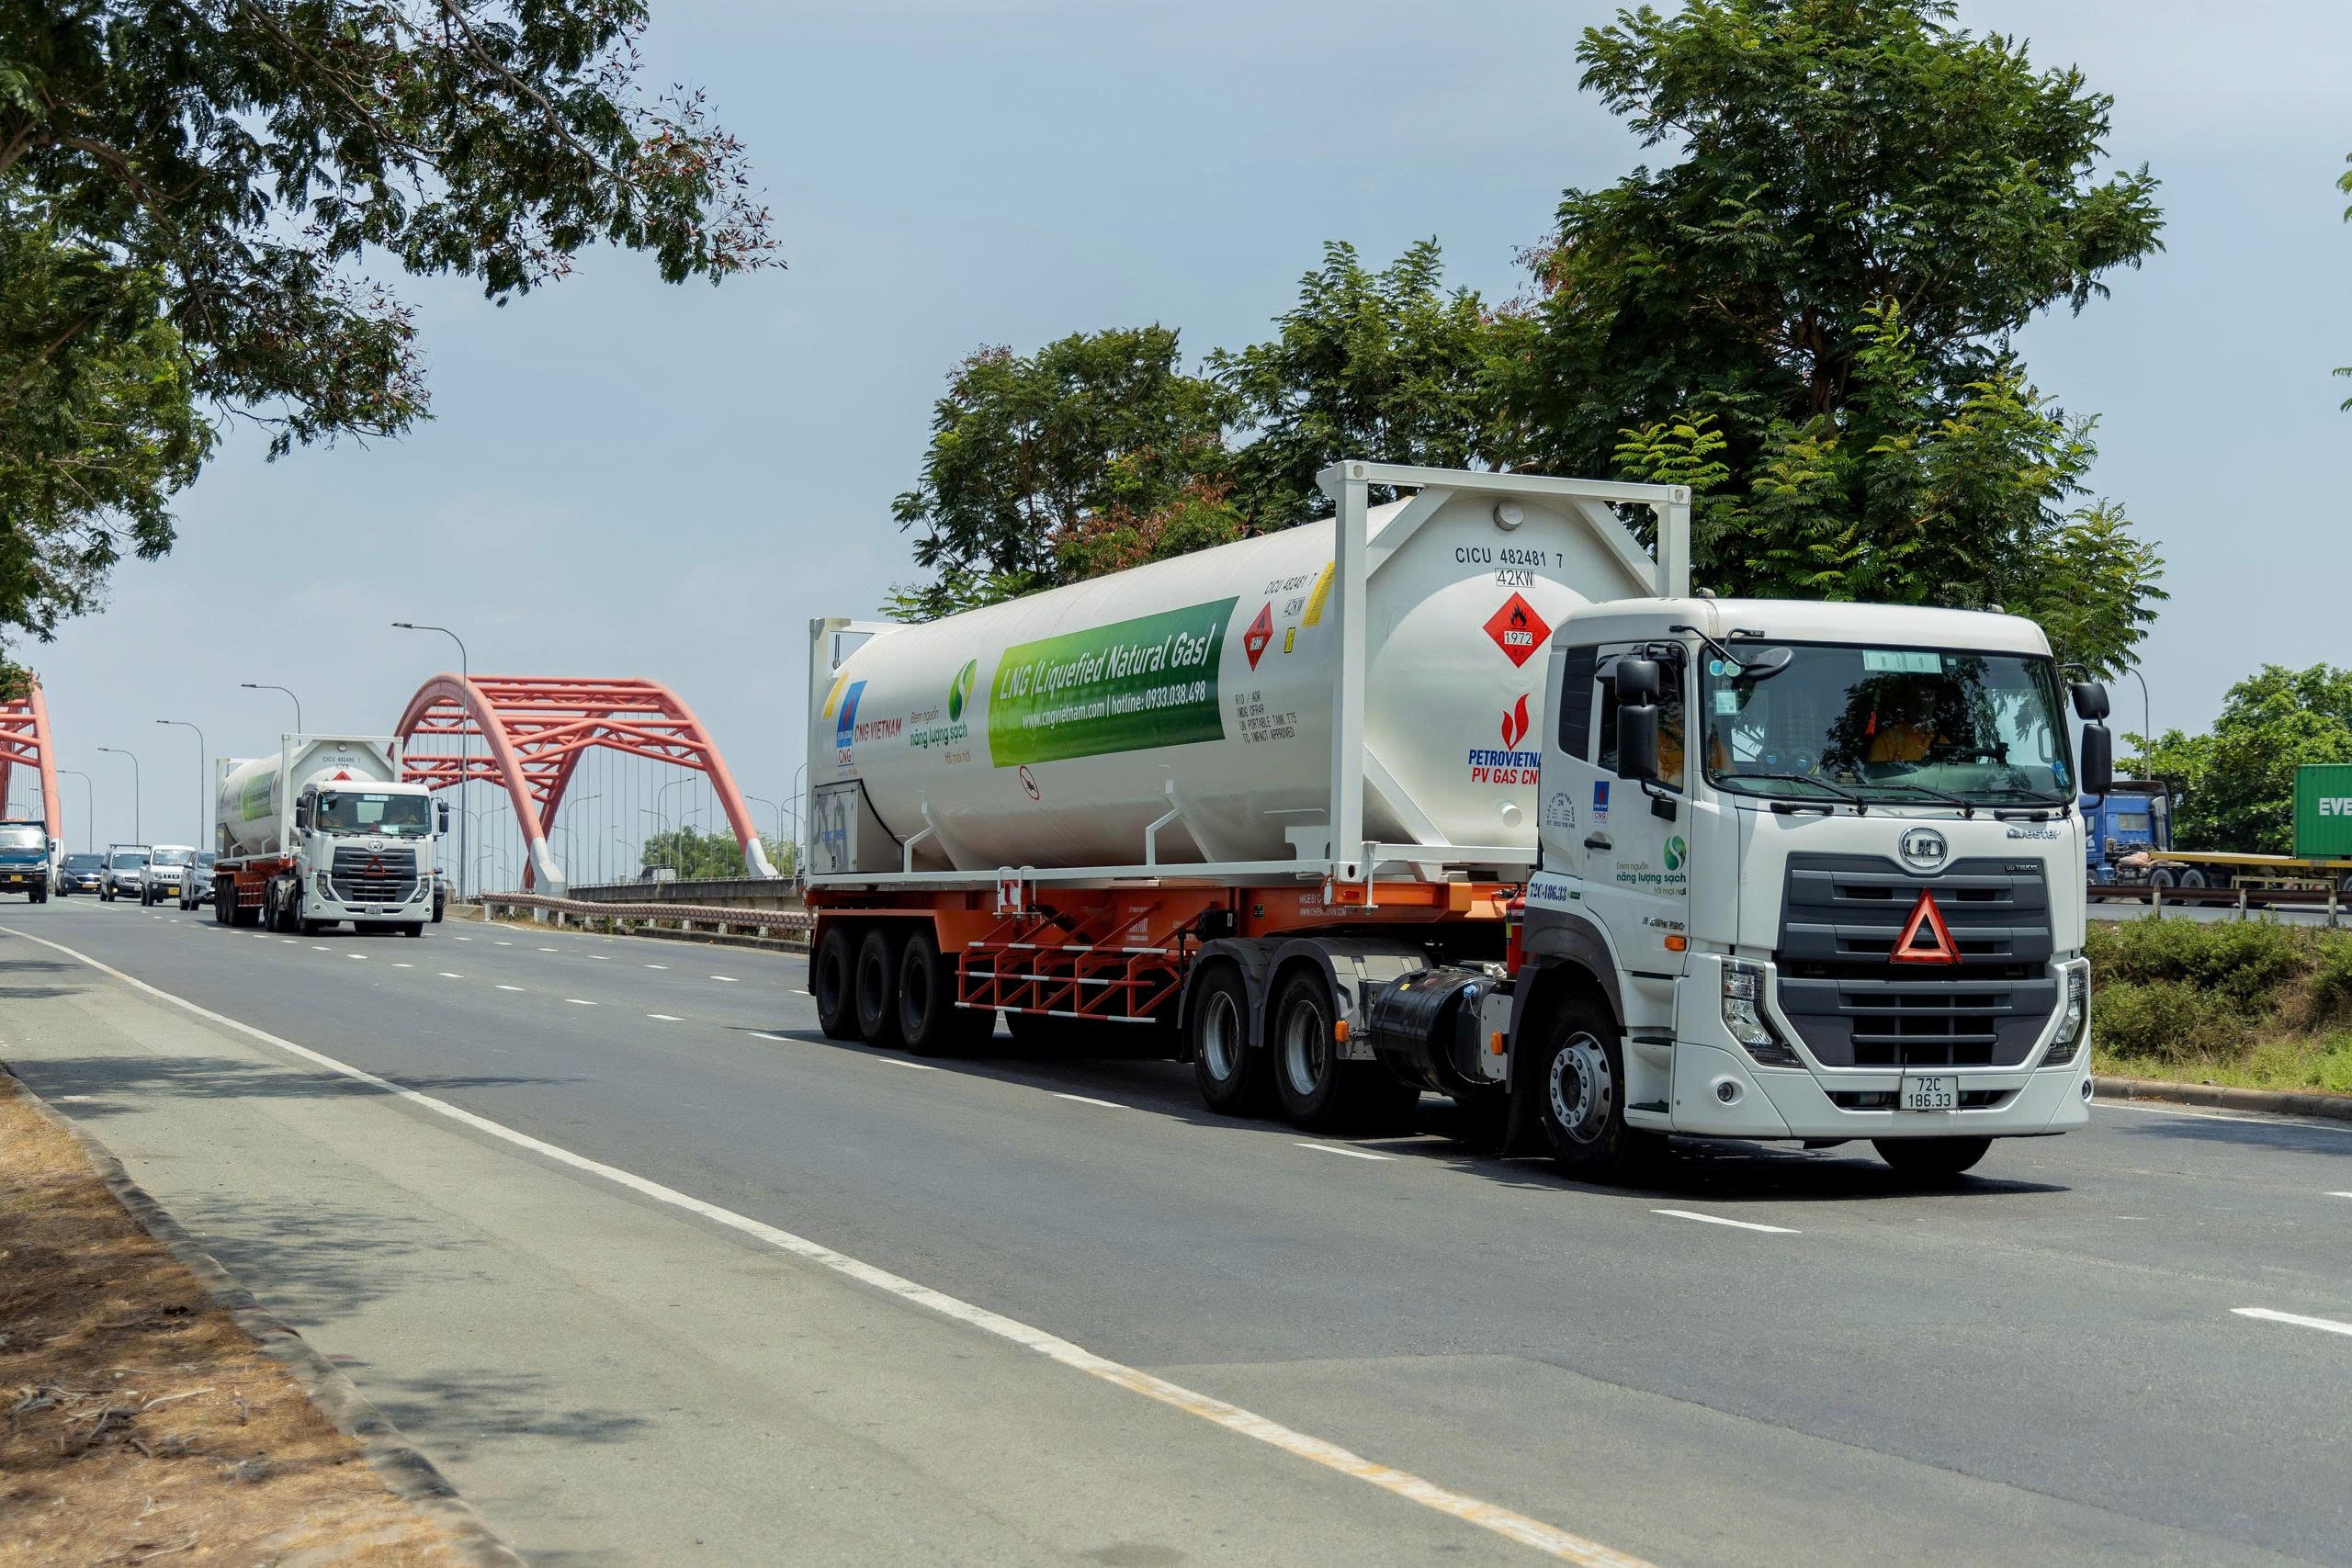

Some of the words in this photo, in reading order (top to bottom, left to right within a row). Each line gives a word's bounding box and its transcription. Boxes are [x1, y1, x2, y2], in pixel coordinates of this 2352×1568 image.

[1455, 547, 1491, 563] CICU
[1500, 548, 1546, 566] 482481
[1556, 553, 1563, 568] 7
[1498, 570, 1532, 586] 42KW
[1504, 632, 1532, 645] 1972
[1000, 664, 1032, 700] LNG
[1030, 648, 1108, 699] (Liquefied
[1105, 634, 1171, 680] Natural
[1171, 623, 1216, 668] Gas)
[1022, 701, 1104, 730] www.cngvietnam.com
[1112, 692, 1145, 716] hotline:
[1146, 680, 1206, 710] 0933.038.498
[854, 722, 869, 743] CNG
[870, 717, 902, 740] VIETNAM
[1248, 716, 1272, 730] PORTABLE
[1272, 714, 1286, 727] TANK
[910, 728, 928, 750] năng
[949, 720, 967, 744] sạch
[1270, 726, 1295, 740] APPROVED
[838, 748, 852, 764] CNG
[1472, 767, 1489, 783] PV
[1493, 769, 1518, 784] GAS
[1521, 770, 1540, 784] CN
[2319, 797, 2352, 816] EVE
[2007, 827, 2061, 840] Quester
[1905, 838, 1944, 857] UD
[1617, 872, 1636, 884] năng
[1638, 873, 1661, 885] lượng
[1664, 873, 1686, 885] sạch
[1917, 1077, 1941, 1091] 72C
[1908, 1093, 1951, 1108] 186.33
